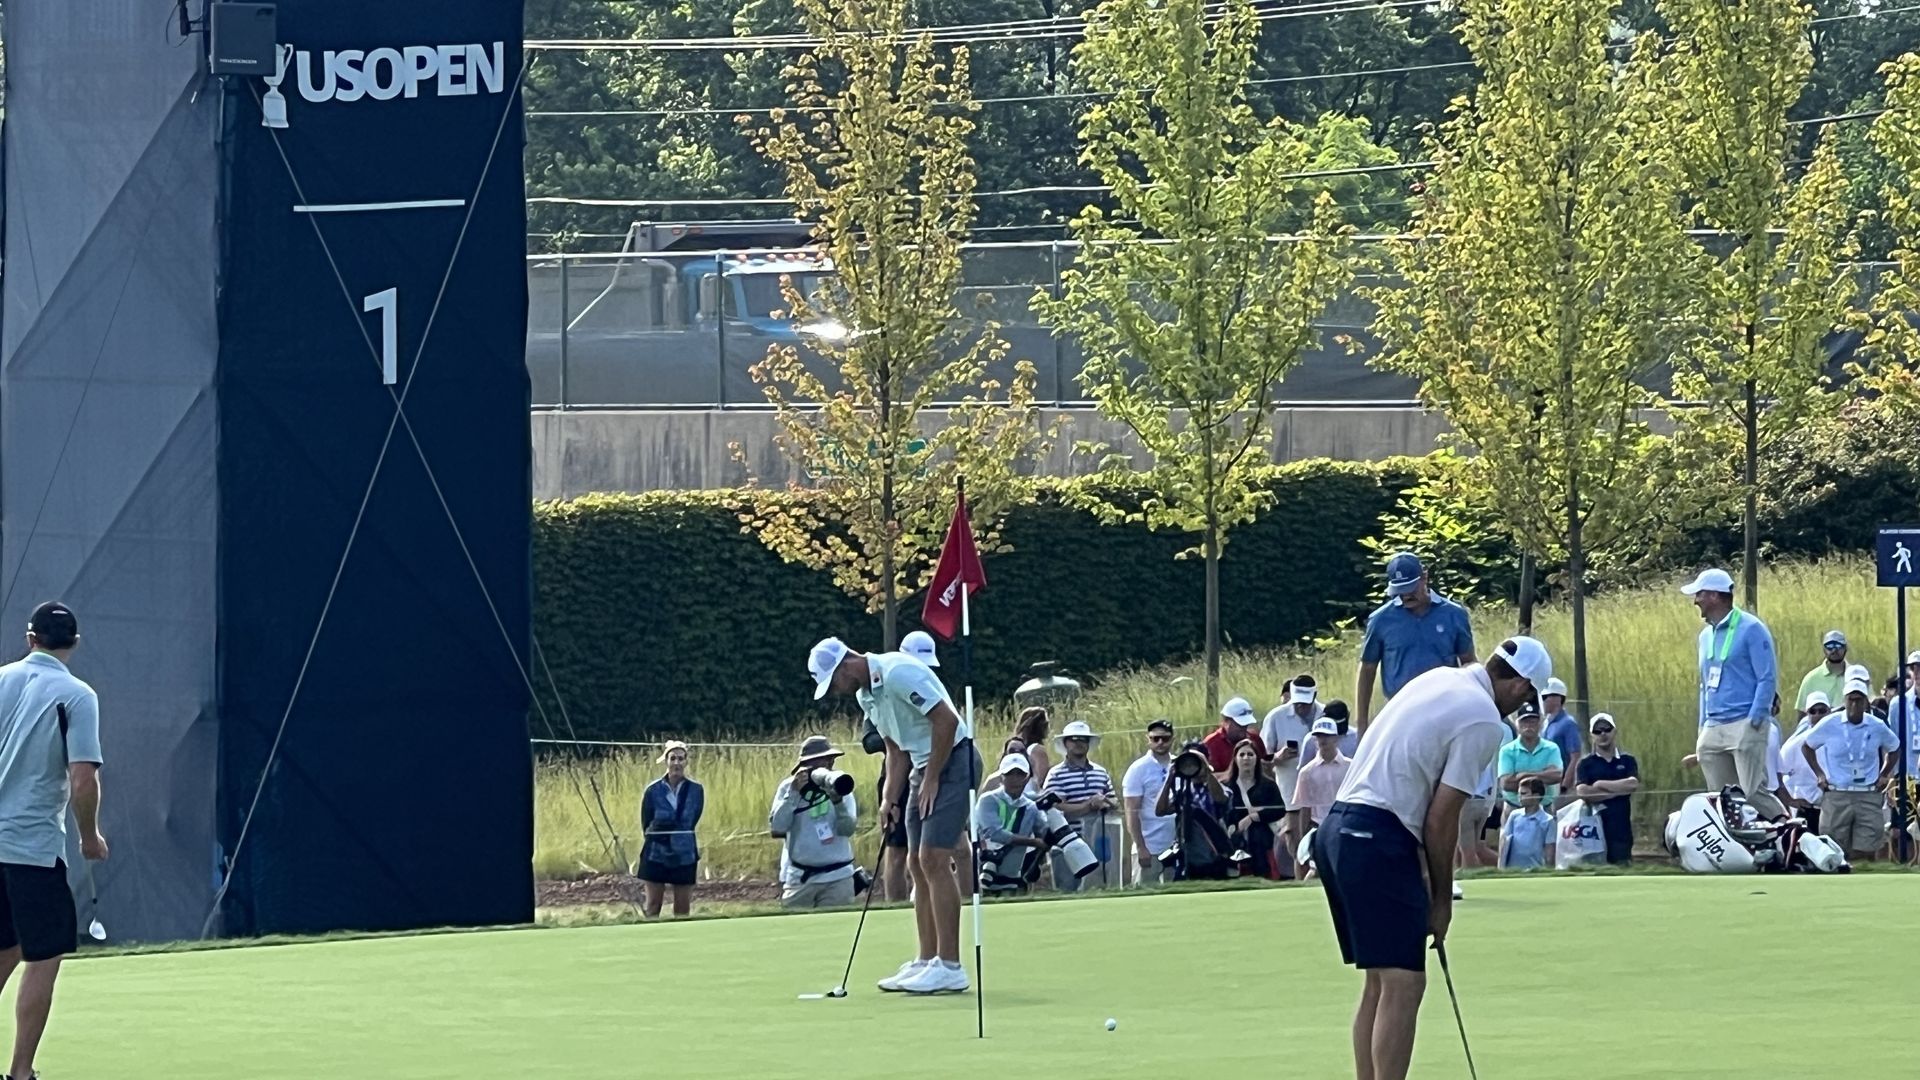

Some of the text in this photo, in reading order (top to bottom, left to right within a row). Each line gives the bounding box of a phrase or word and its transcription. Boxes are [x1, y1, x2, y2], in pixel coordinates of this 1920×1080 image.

[363, 286, 397, 385] 1
[1562, 824, 1600, 840] USGA
[1687, 808, 1731, 863] Taylor
